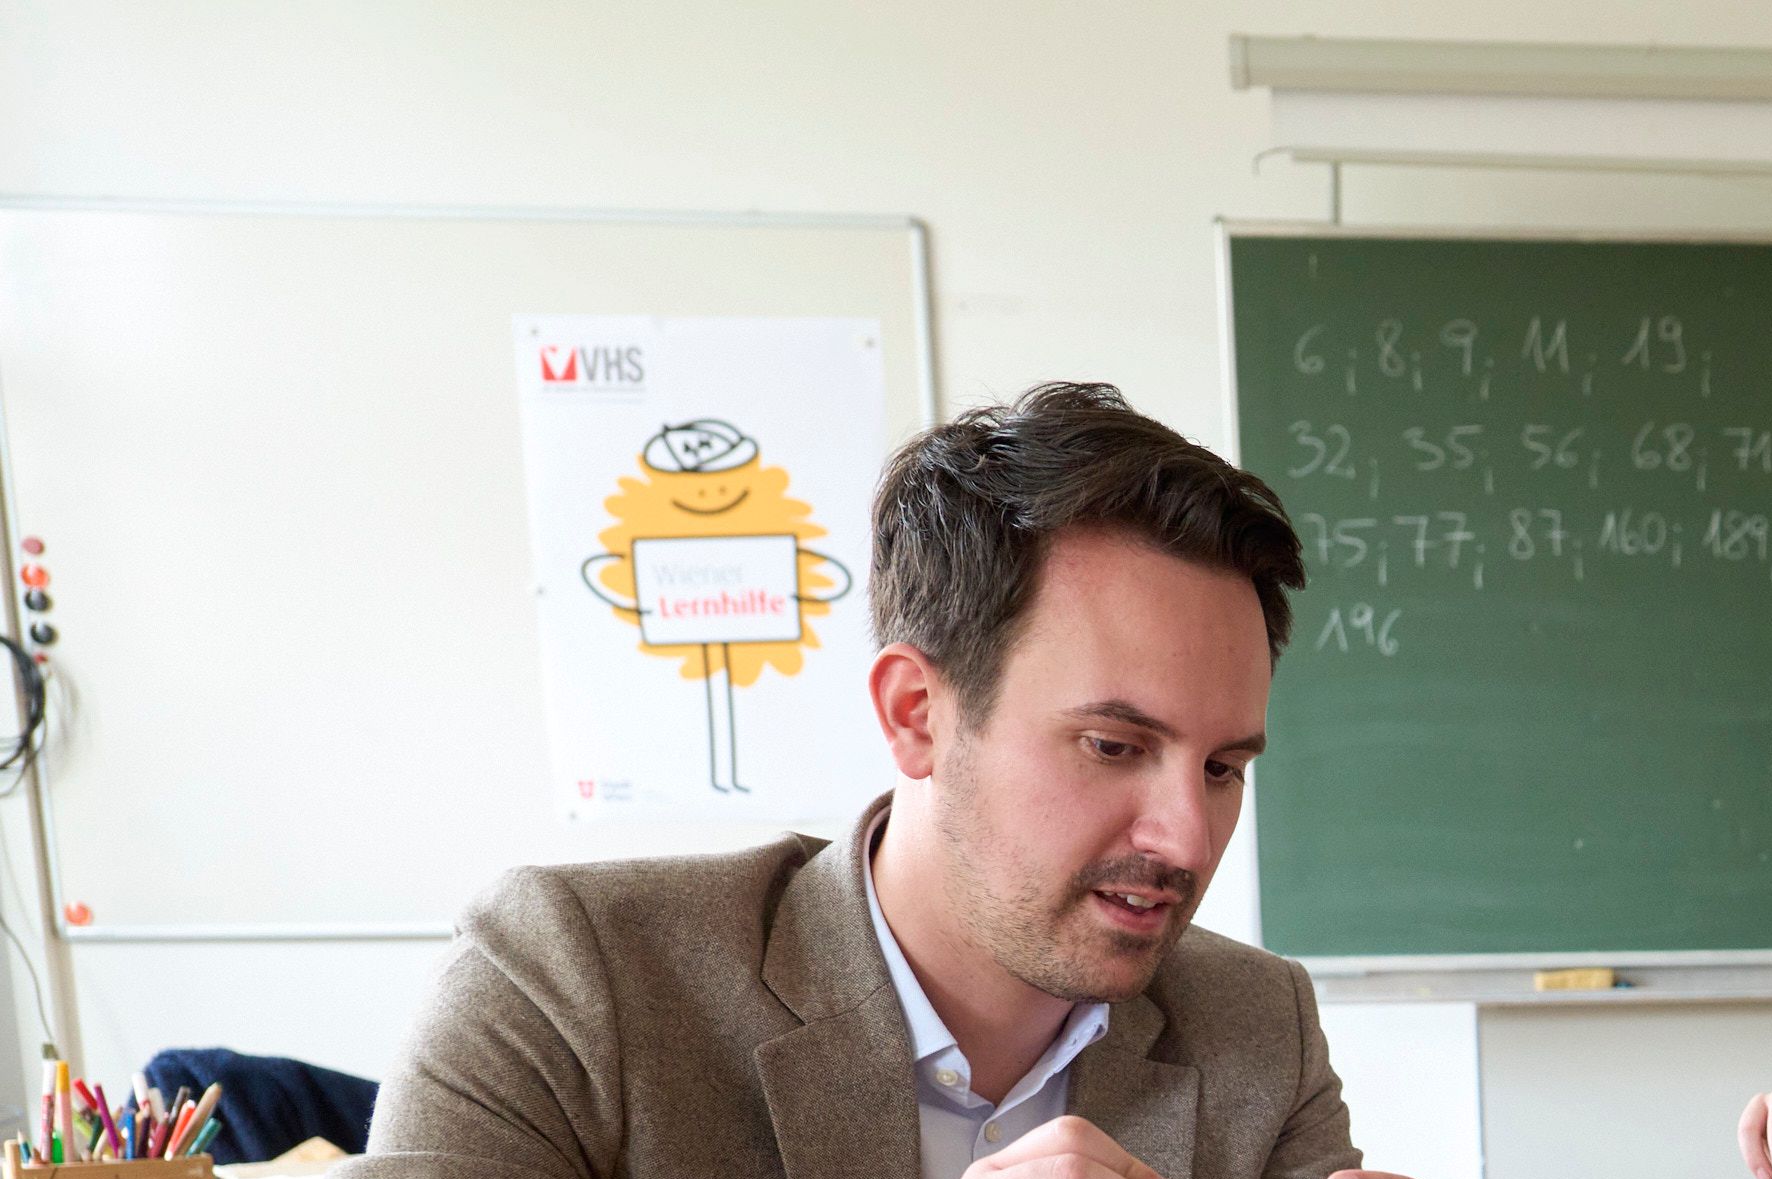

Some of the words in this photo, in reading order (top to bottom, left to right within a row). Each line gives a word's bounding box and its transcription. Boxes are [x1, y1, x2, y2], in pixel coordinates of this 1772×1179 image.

[580, 346, 644, 384] VHS
[657, 588, 786, 620] Lernhilfe
[1314, 601, 1403, 658] 196
